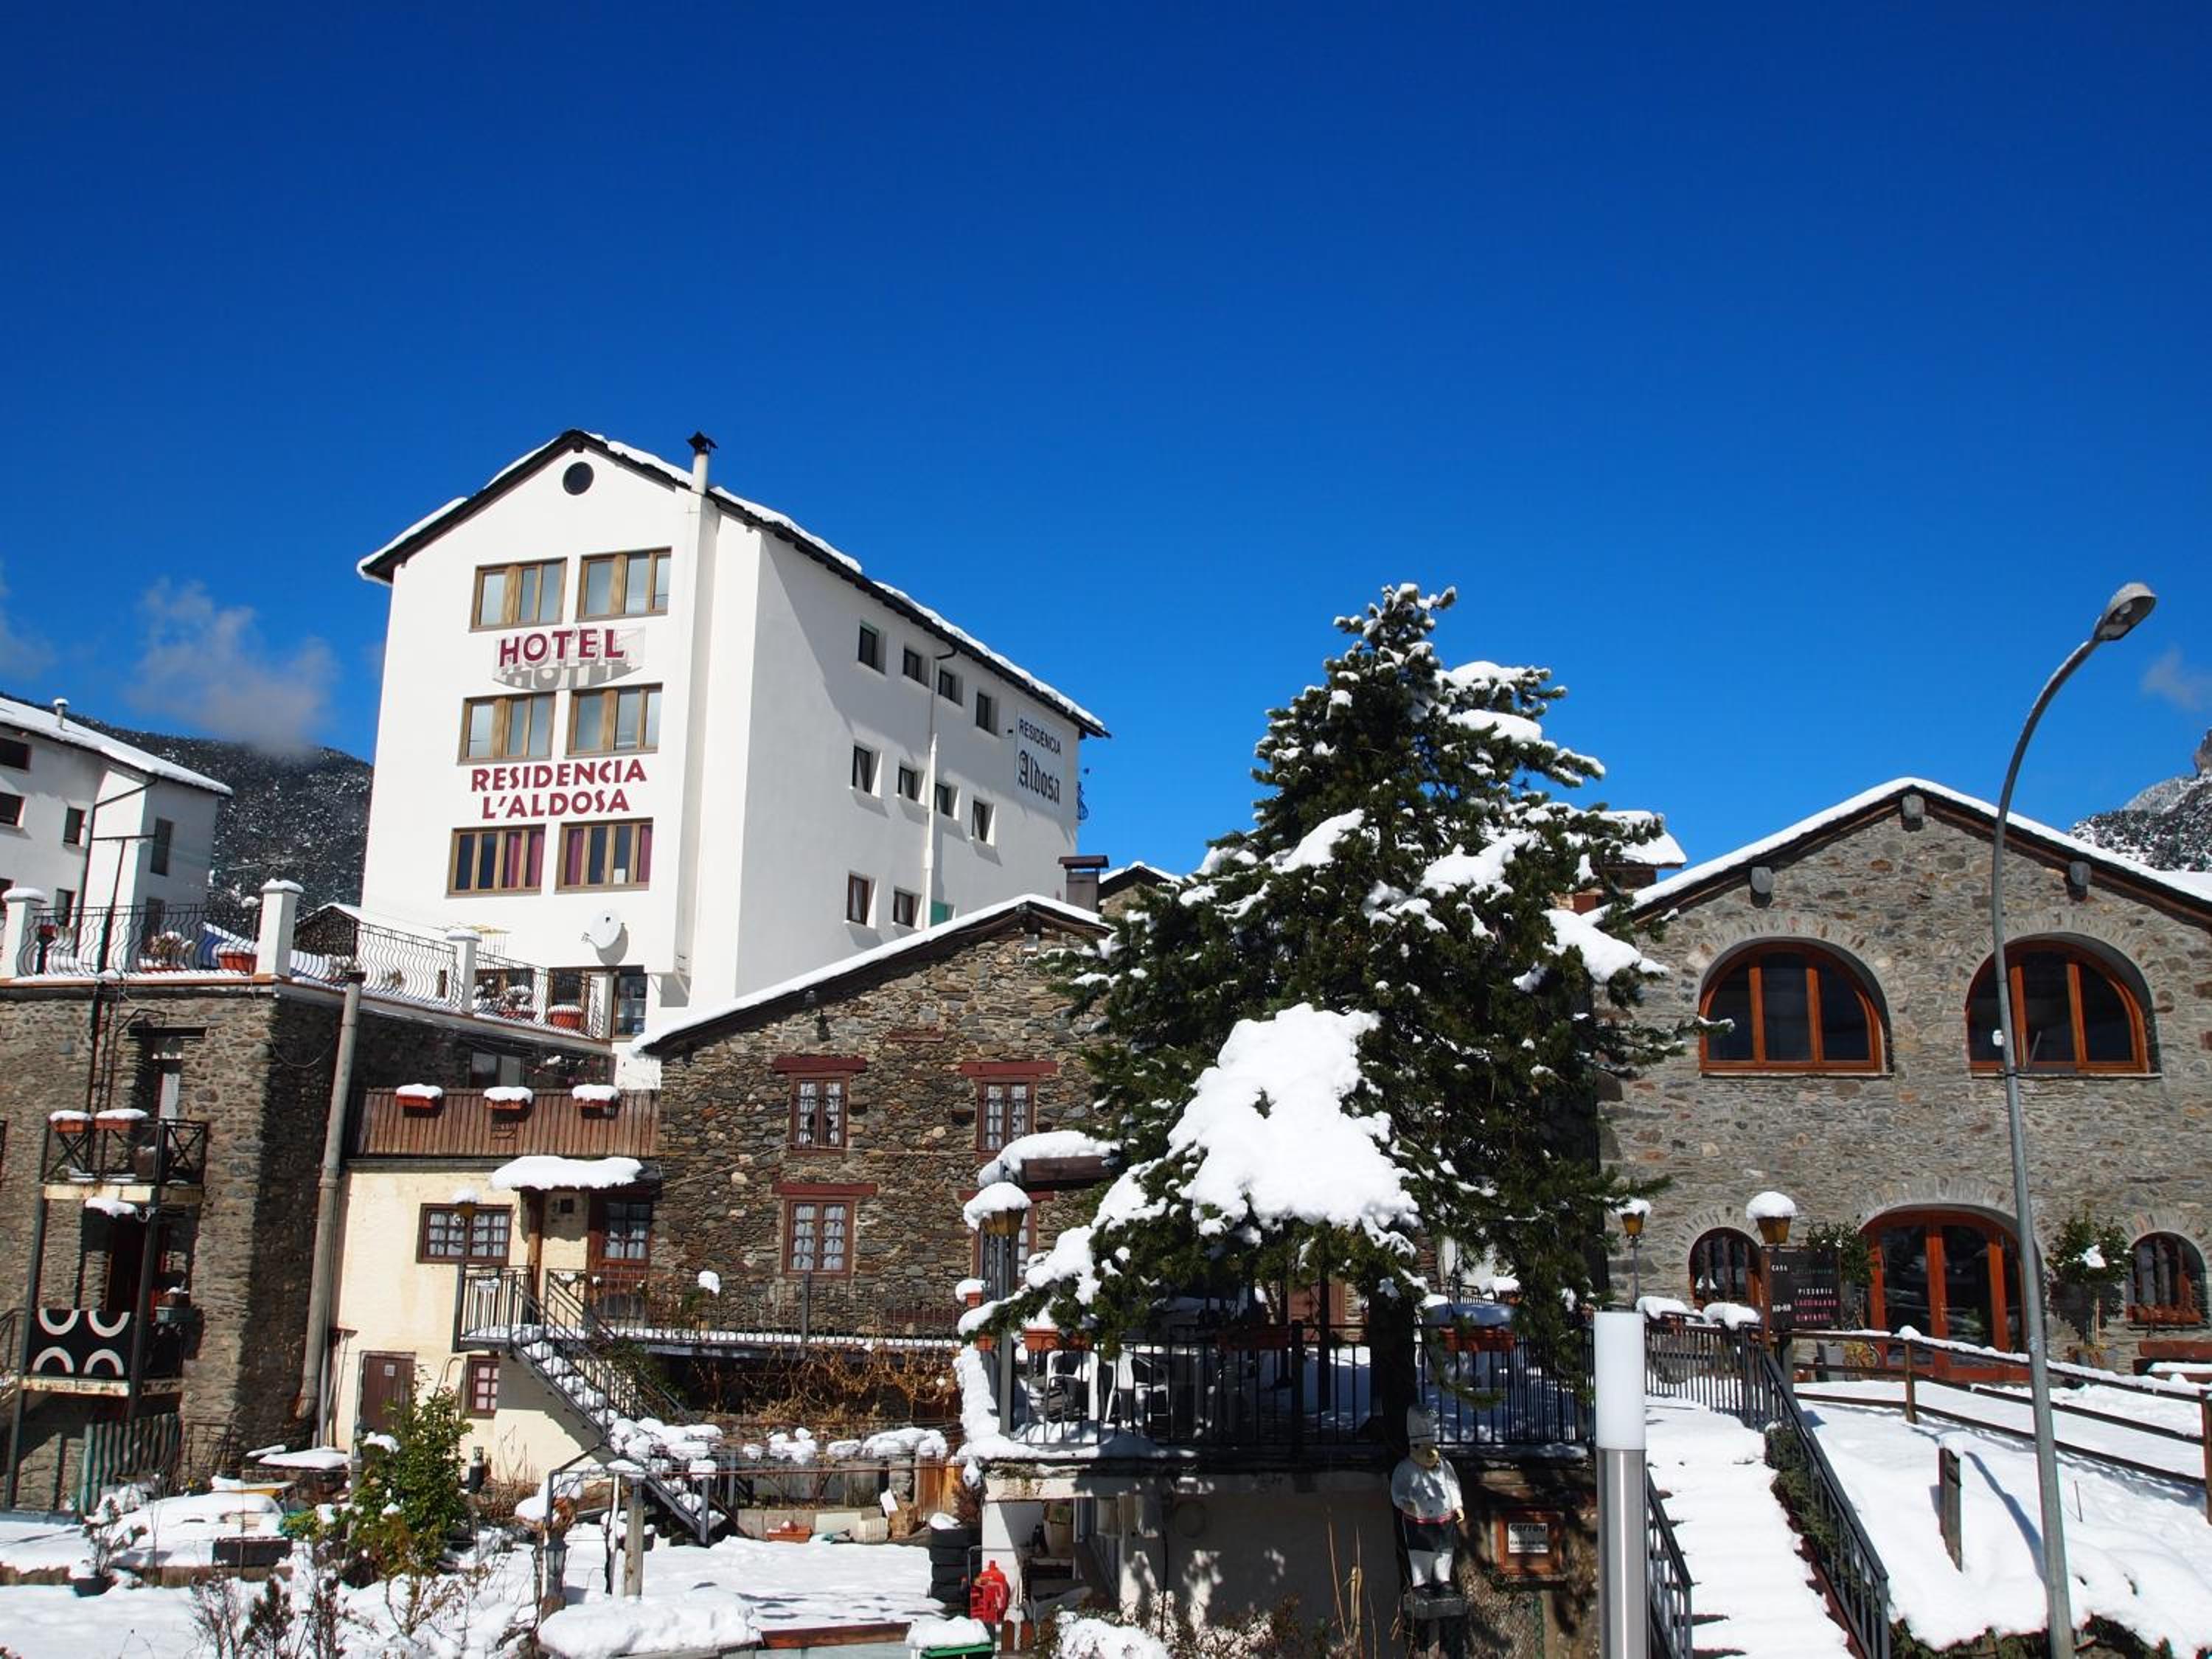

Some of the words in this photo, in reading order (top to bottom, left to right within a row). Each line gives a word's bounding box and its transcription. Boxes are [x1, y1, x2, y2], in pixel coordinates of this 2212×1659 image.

[499, 629, 625, 667] HOTEL
[472, 759, 647, 792] RESIDENCIA
[1018, 749, 1060, 806] Aldosa
[482, 789, 630, 820] L'ALDOSA
